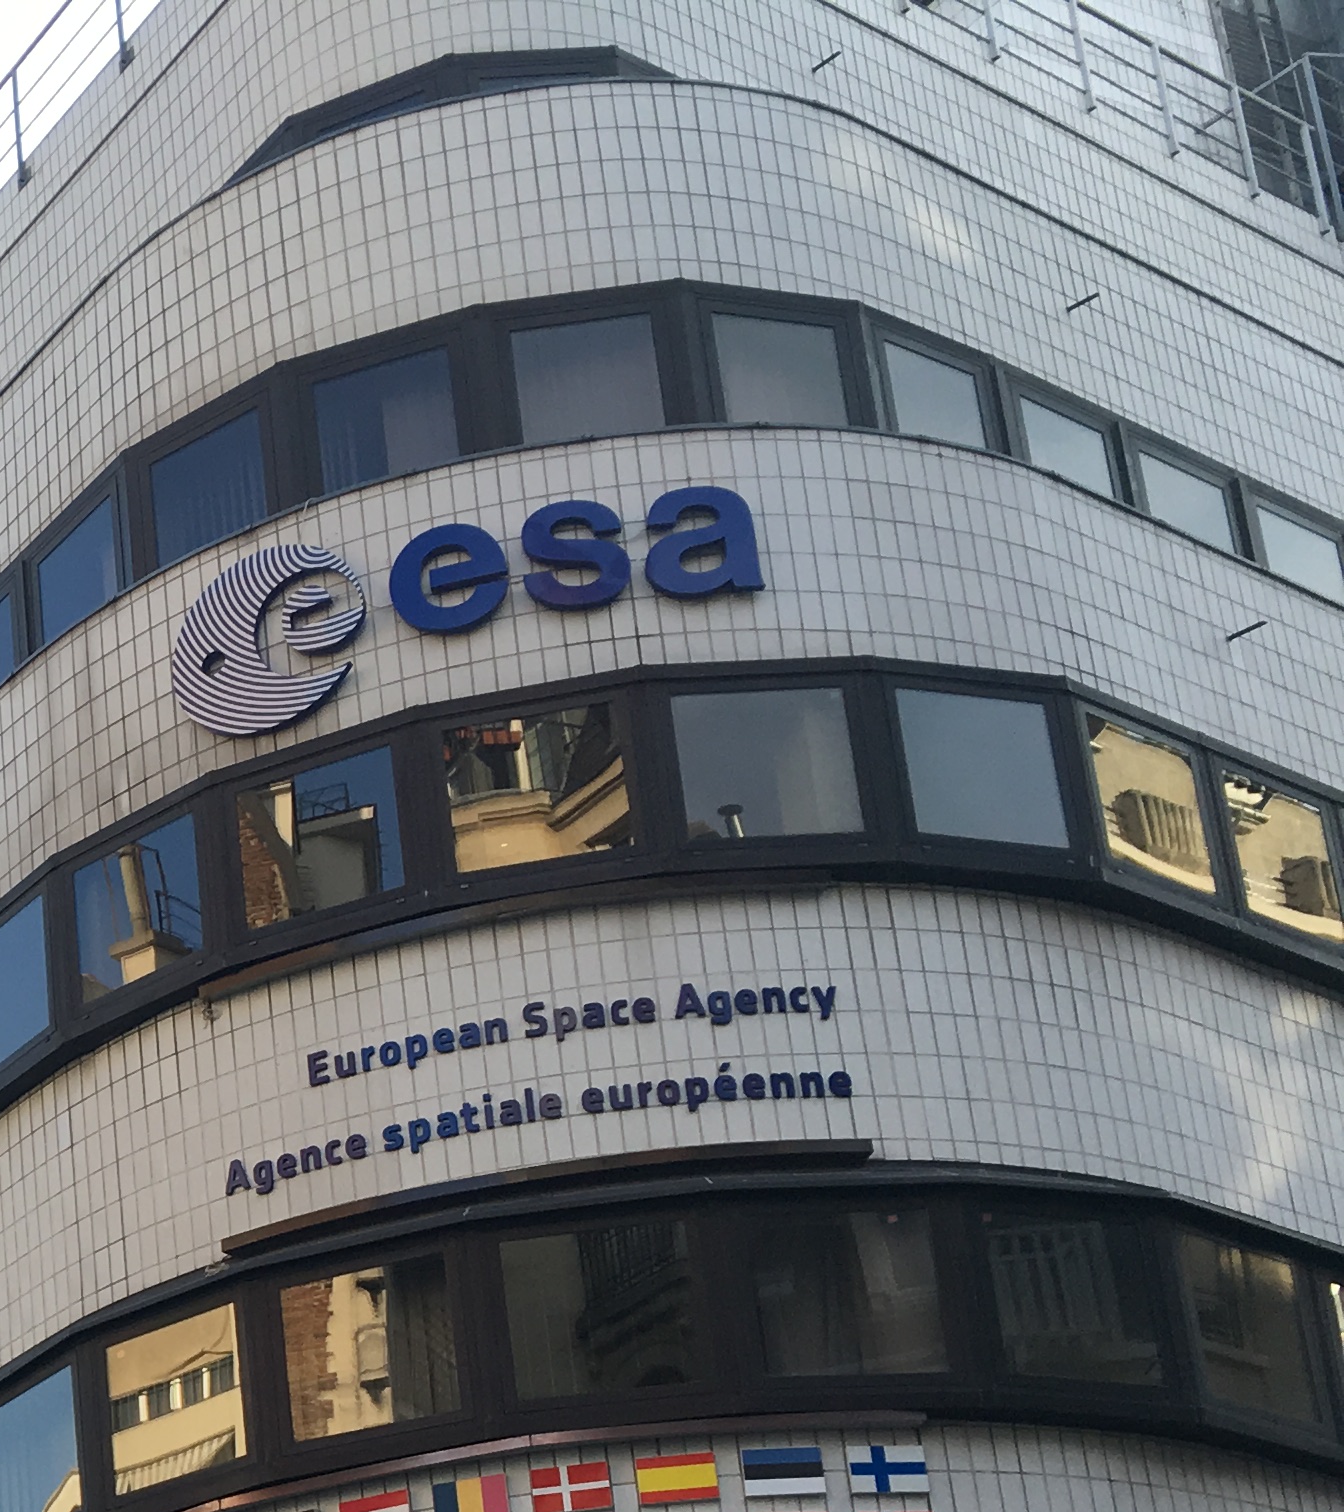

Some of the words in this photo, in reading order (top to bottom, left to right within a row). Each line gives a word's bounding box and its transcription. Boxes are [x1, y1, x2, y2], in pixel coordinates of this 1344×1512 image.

[389, 486, 765, 633] esa
[306, 1012, 508, 1087] European
[523, 995, 657, 1043] Space
[674, 983, 836, 1026] Agency
[225, 1131, 368, 1196] Agence
[382, 1088, 563, 1154] spatiale
[580, 1062, 854, 1113] européenne
